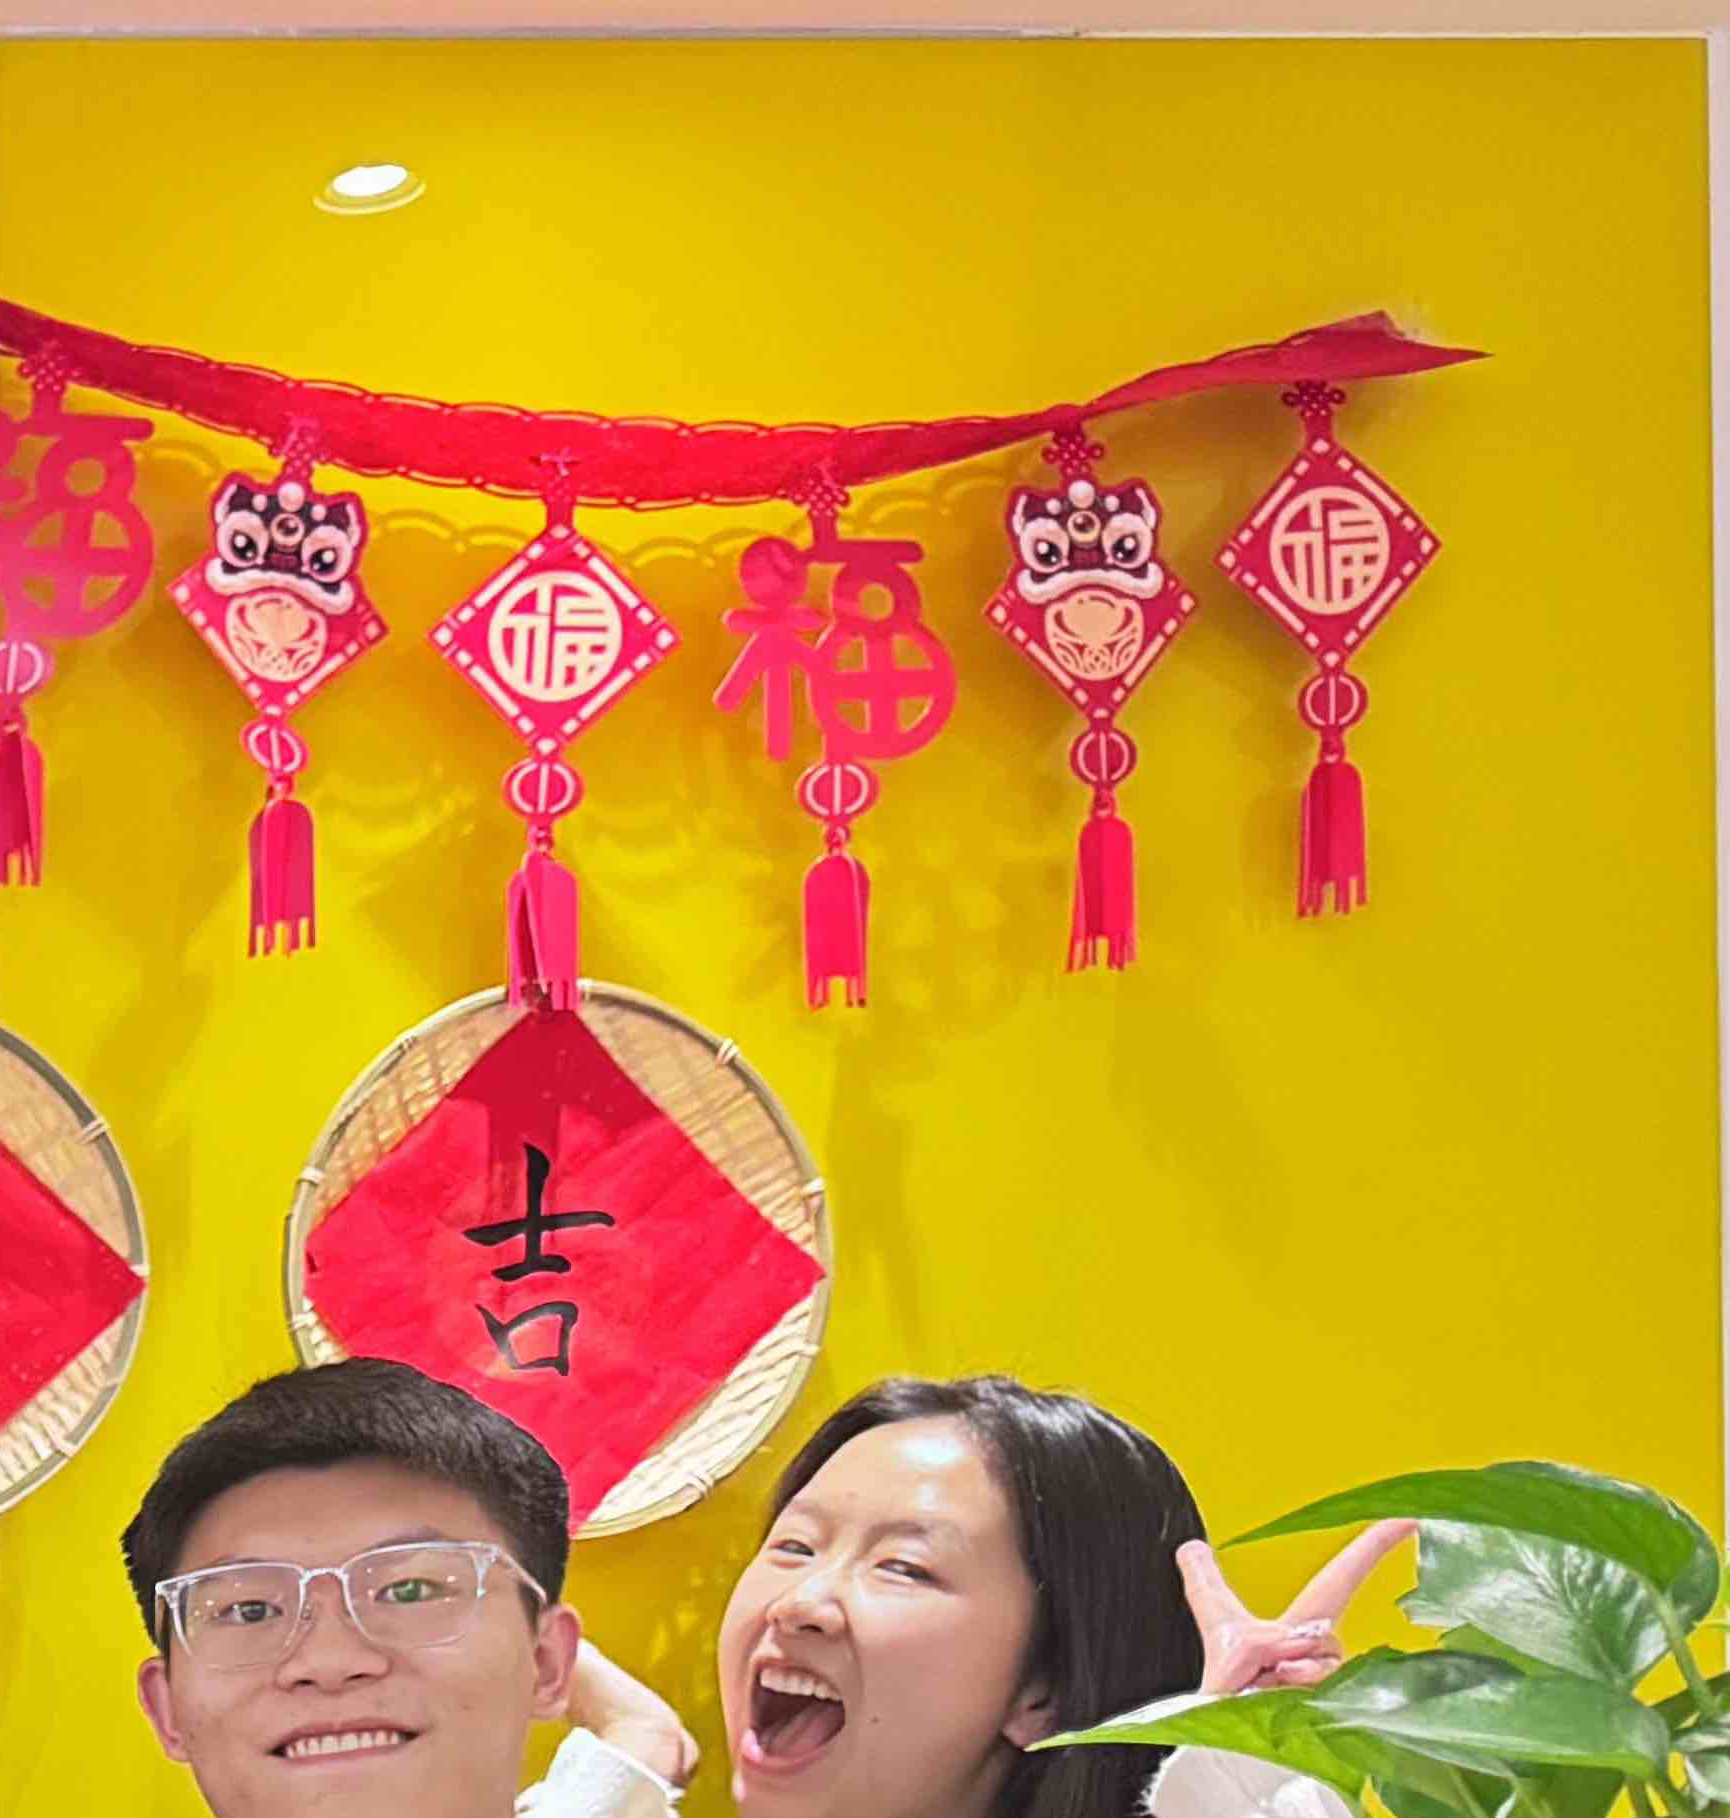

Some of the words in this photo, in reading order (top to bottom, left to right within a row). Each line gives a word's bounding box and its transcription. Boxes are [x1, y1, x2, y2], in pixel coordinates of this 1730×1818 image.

[487, 570, 622, 703] 福
[1267, 484, 1390, 616] 福
[712, 534, 957, 763] 福
[463, 1142, 617, 1377] 吉
